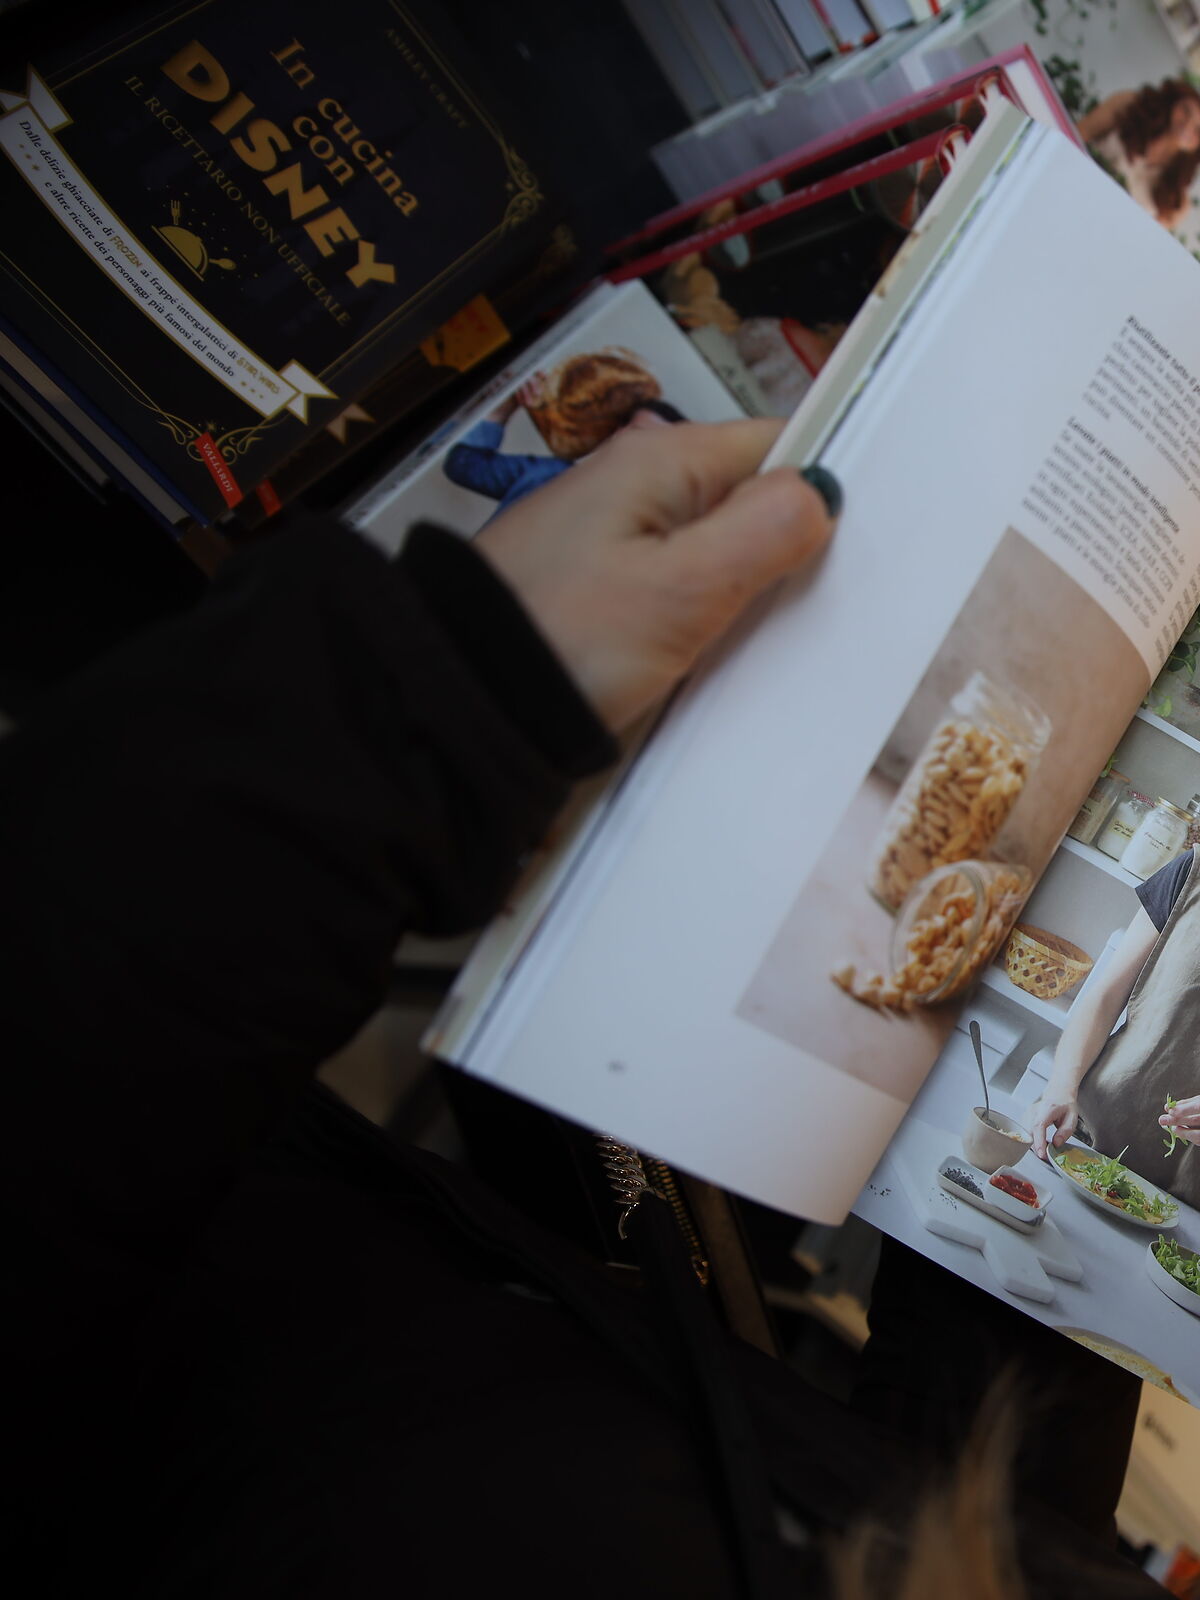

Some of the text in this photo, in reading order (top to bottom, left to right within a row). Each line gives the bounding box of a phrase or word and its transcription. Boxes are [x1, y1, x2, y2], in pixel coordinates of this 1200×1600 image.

[270, 37, 315, 90] In
[124, 76, 351, 327] IL RICETTARIO NON UFFICIALE
[160, 39, 396, 288] DISNEY
[292, 116, 355, 186] con
[317, 98, 419, 217] cucina
[19, 121, 42, 147] Dalle
[40, 149, 66, 180] delizie
[62, 181, 104, 226] ghiacciate
[102, 225, 116, 237] di
[110, 235, 142, 268] FROZEN
[140, 267, 152, 278] ai
[150, 277, 179, 304] frappé
[176, 303, 228, 351] intergalattici
[227, 349, 239, 360] di
[50, 189, 71, 211] altre
[69, 211, 95, 240] ricette
[94, 240, 108, 256] dei
[105, 254, 152, 299] personaggi
[148, 299, 165, 314] più
[164, 313, 194, 340] famosi
[192, 339, 208, 352] del
[206, 351, 234, 377] mondo
[203, 443, 233, 492] VALLARDI
